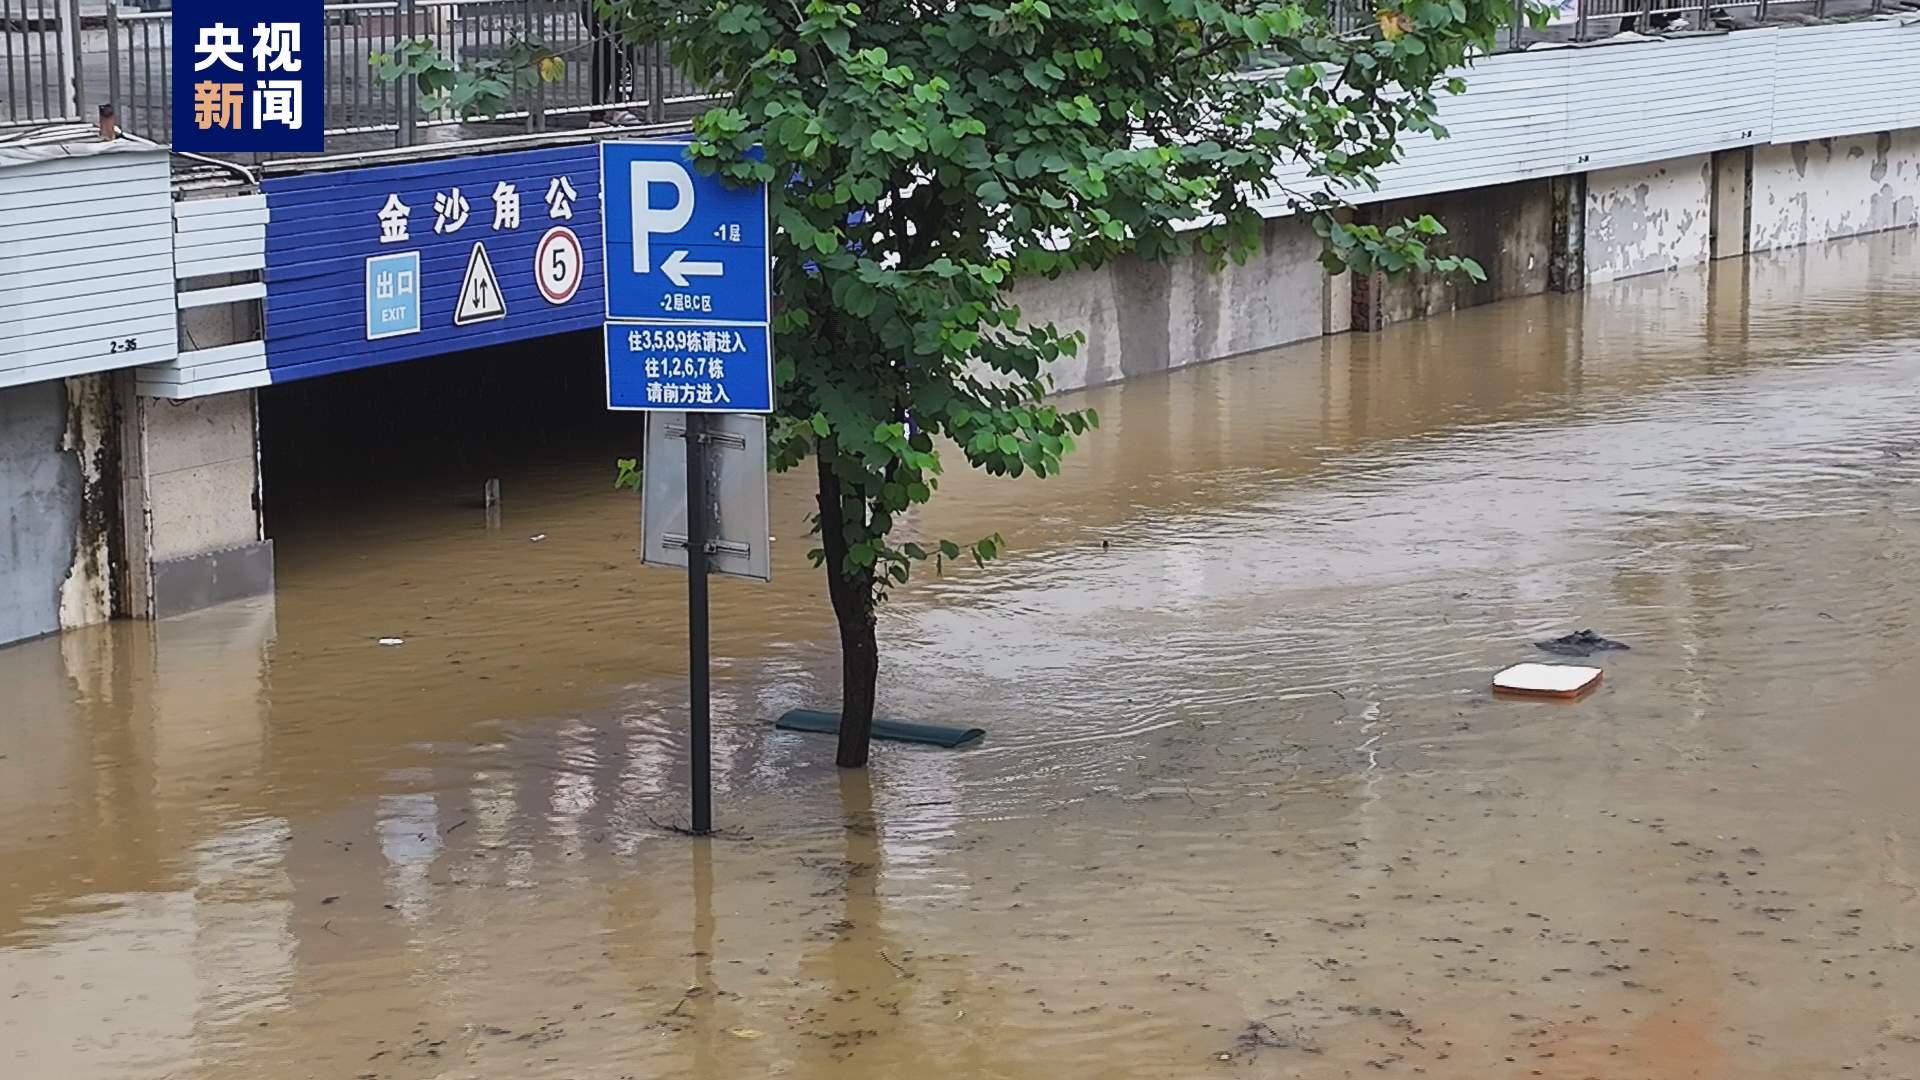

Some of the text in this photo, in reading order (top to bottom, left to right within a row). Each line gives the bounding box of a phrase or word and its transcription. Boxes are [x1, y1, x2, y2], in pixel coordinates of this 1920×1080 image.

[630, 160, 696, 273] P
[552, 248, 567, 282] 5
[376, 269, 414, 299] 出口
[381, 306, 407, 323] EXIT
[646, 381, 731, 404] 请前方进入
